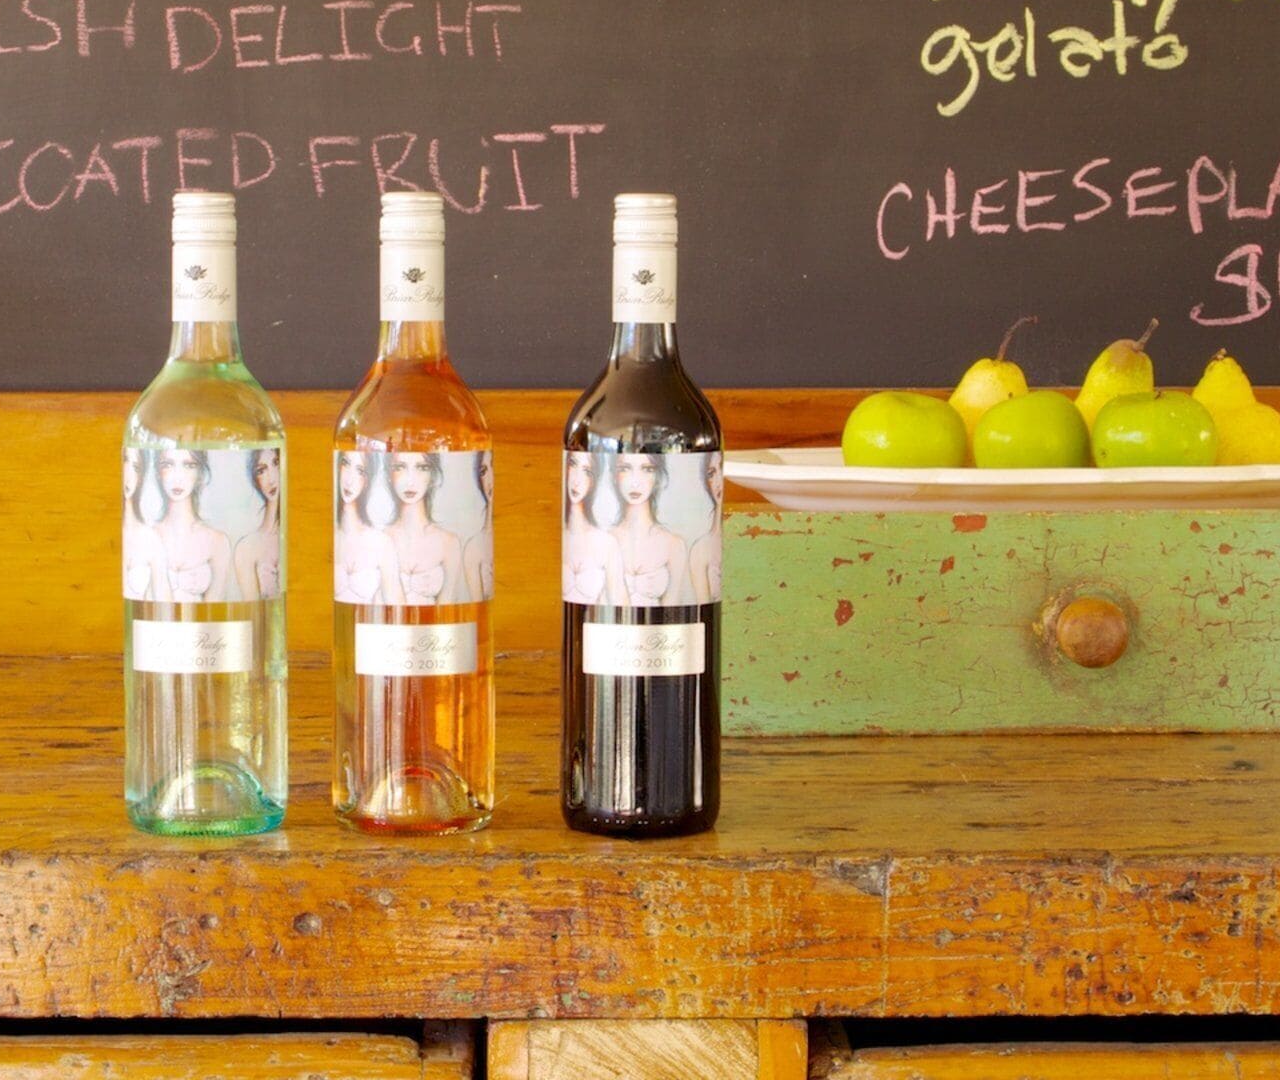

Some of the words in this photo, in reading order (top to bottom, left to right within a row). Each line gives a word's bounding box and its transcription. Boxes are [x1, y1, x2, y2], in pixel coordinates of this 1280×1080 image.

[165, 0, 521, 73] DELIGHT
[920, 0, 1188, 117] gelato
[309, 124, 606, 210] FRUIT
